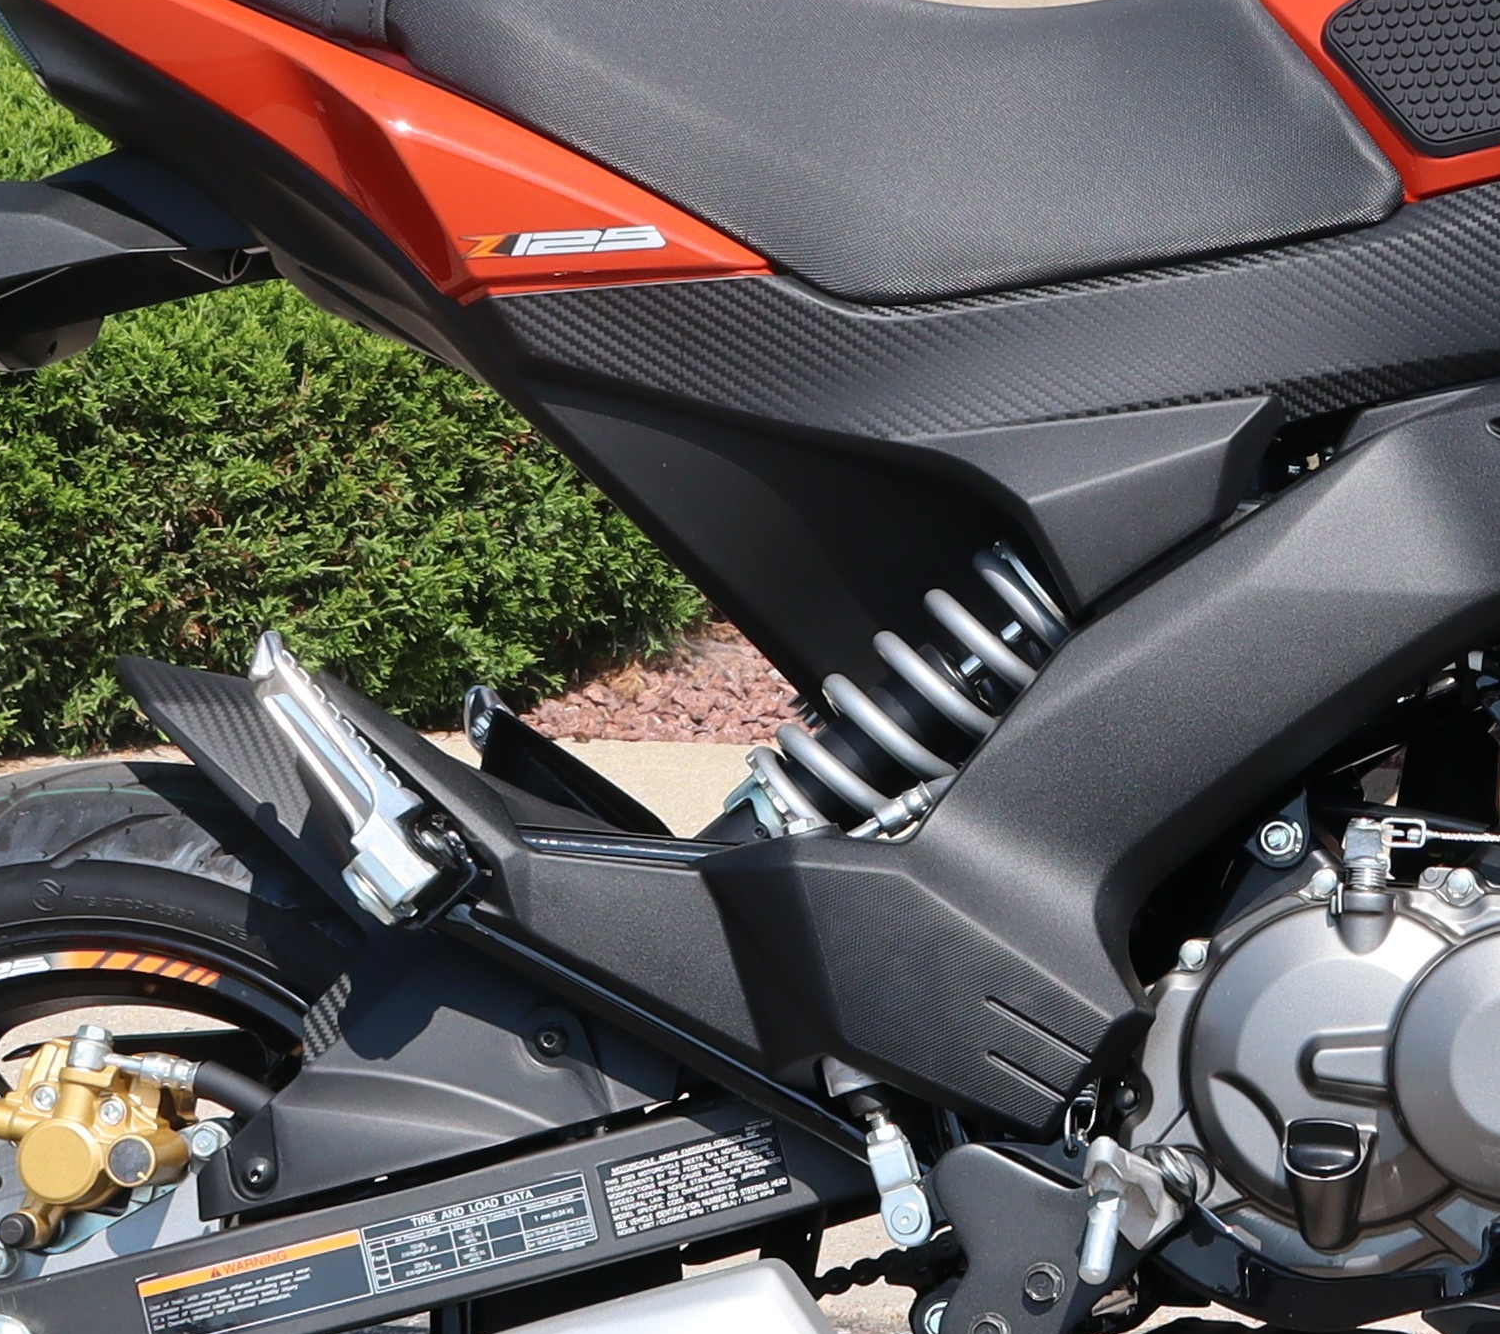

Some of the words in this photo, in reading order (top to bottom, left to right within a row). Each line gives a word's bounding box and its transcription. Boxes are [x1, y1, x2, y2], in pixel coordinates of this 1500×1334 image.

[459, 225, 667, 260] Z125
[410, 1216, 437, 1228] TIRE
[441, 1206, 465, 1220] AND
[469, 1198, 500, 1213] LOAD
[503, 1189, 534, 1204] DATA
[223, 1251, 288, 1274] WARNING
